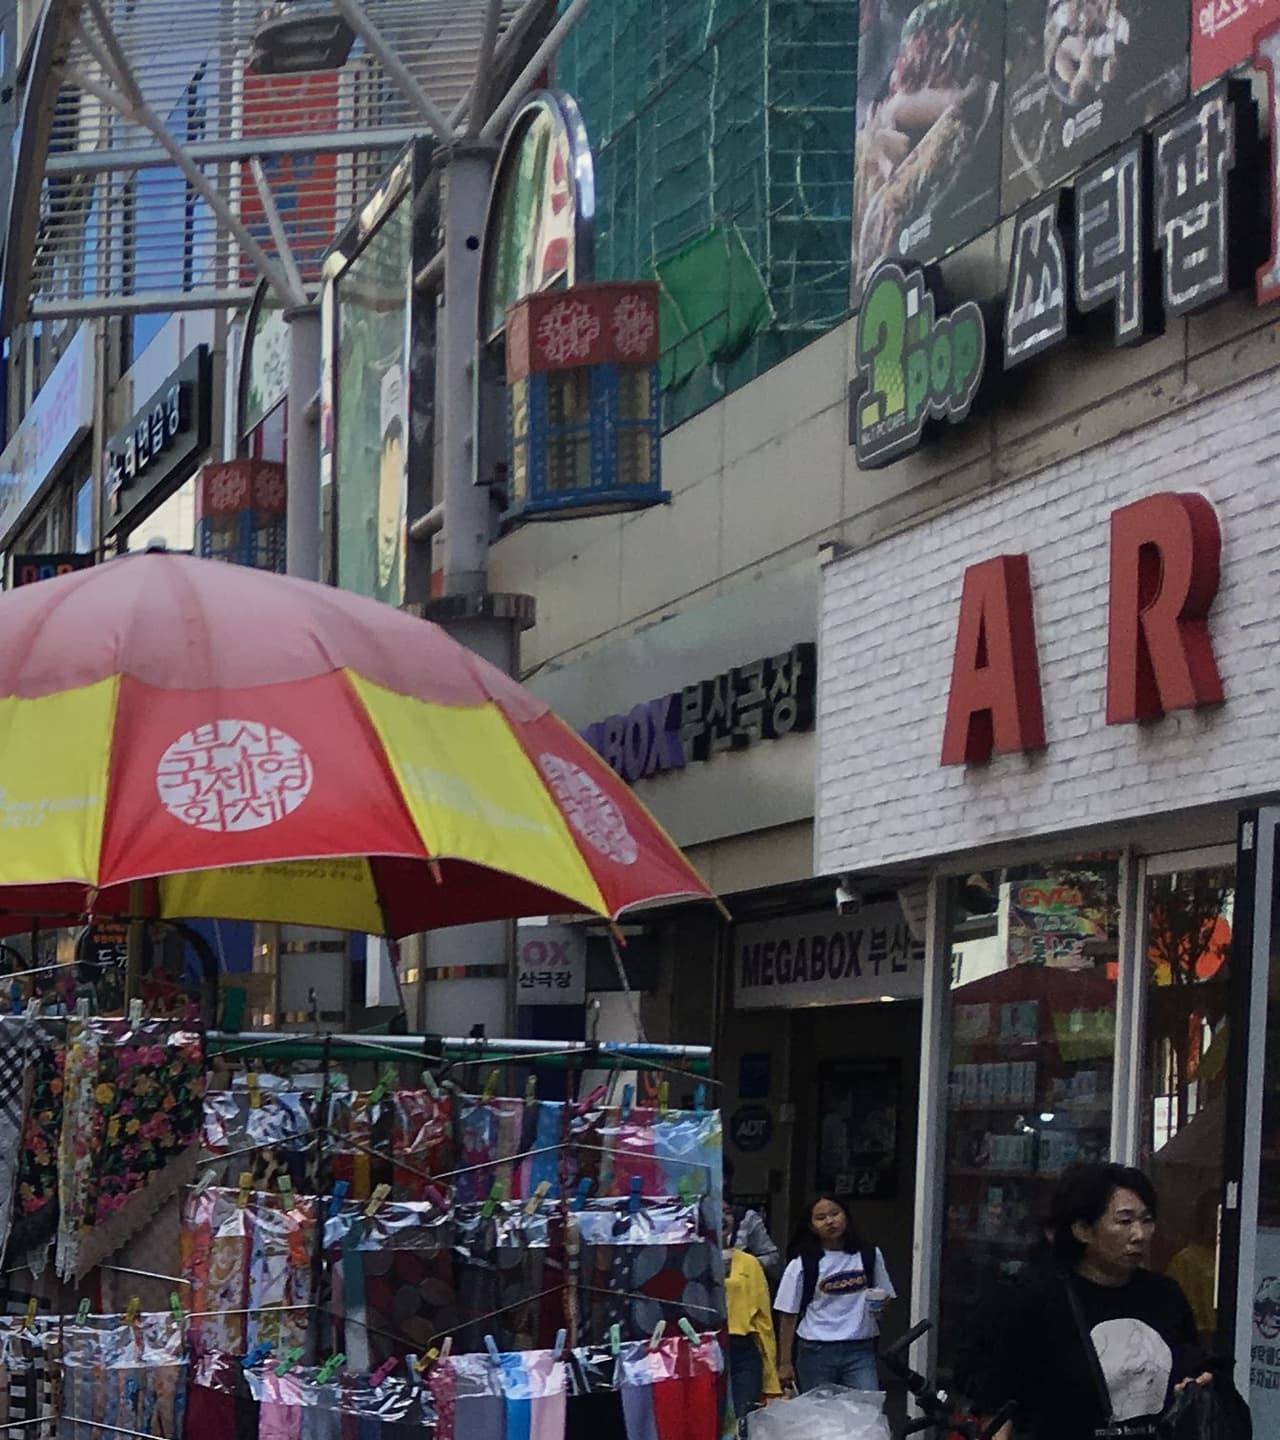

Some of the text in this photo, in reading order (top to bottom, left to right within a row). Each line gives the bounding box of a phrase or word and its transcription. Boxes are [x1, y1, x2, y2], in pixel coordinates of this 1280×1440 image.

[1004, 96, 1237, 362] 쓰리팝
[682, 648, 804, 757] 부산극장
[518, 970, 573, 989] 산극장
[740, 929, 865, 988] MEGABOX
[735, 1119, 767, 1137] ADT
